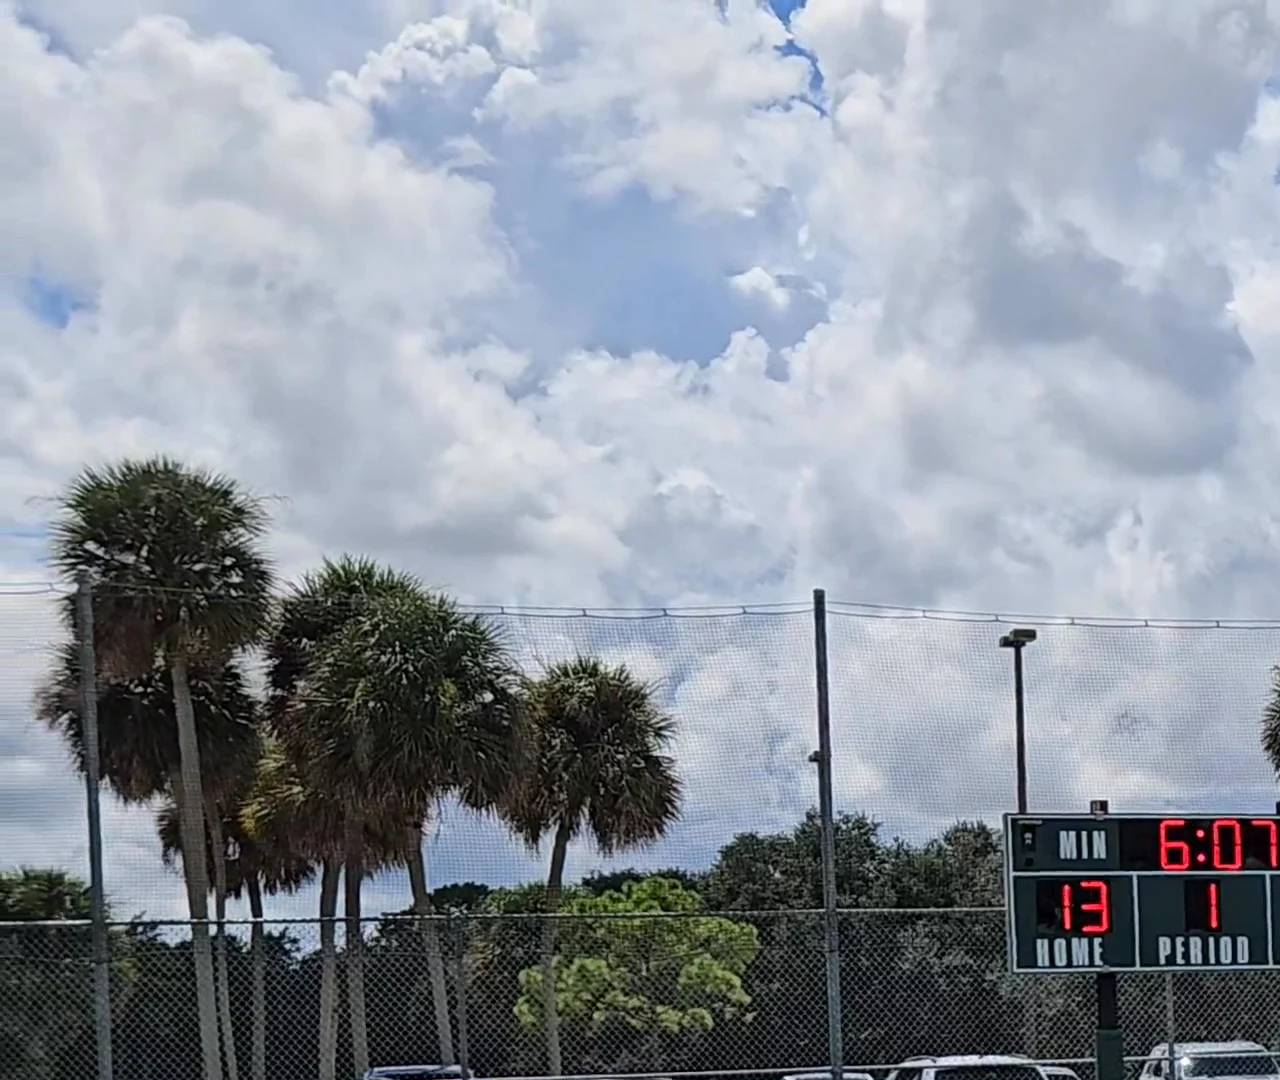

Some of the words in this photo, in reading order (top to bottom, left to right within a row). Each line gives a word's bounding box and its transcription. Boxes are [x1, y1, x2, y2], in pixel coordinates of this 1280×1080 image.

[1059, 830, 1107, 860] MIN
[1159, 820, 1279, 871] 6:07
[1061, 880, 1108, 933] 13
[1208, 883, 1218, 929] 1
[1036, 937, 1103, 967] HOME
[1158, 936, 1249, 965] PERIOD
